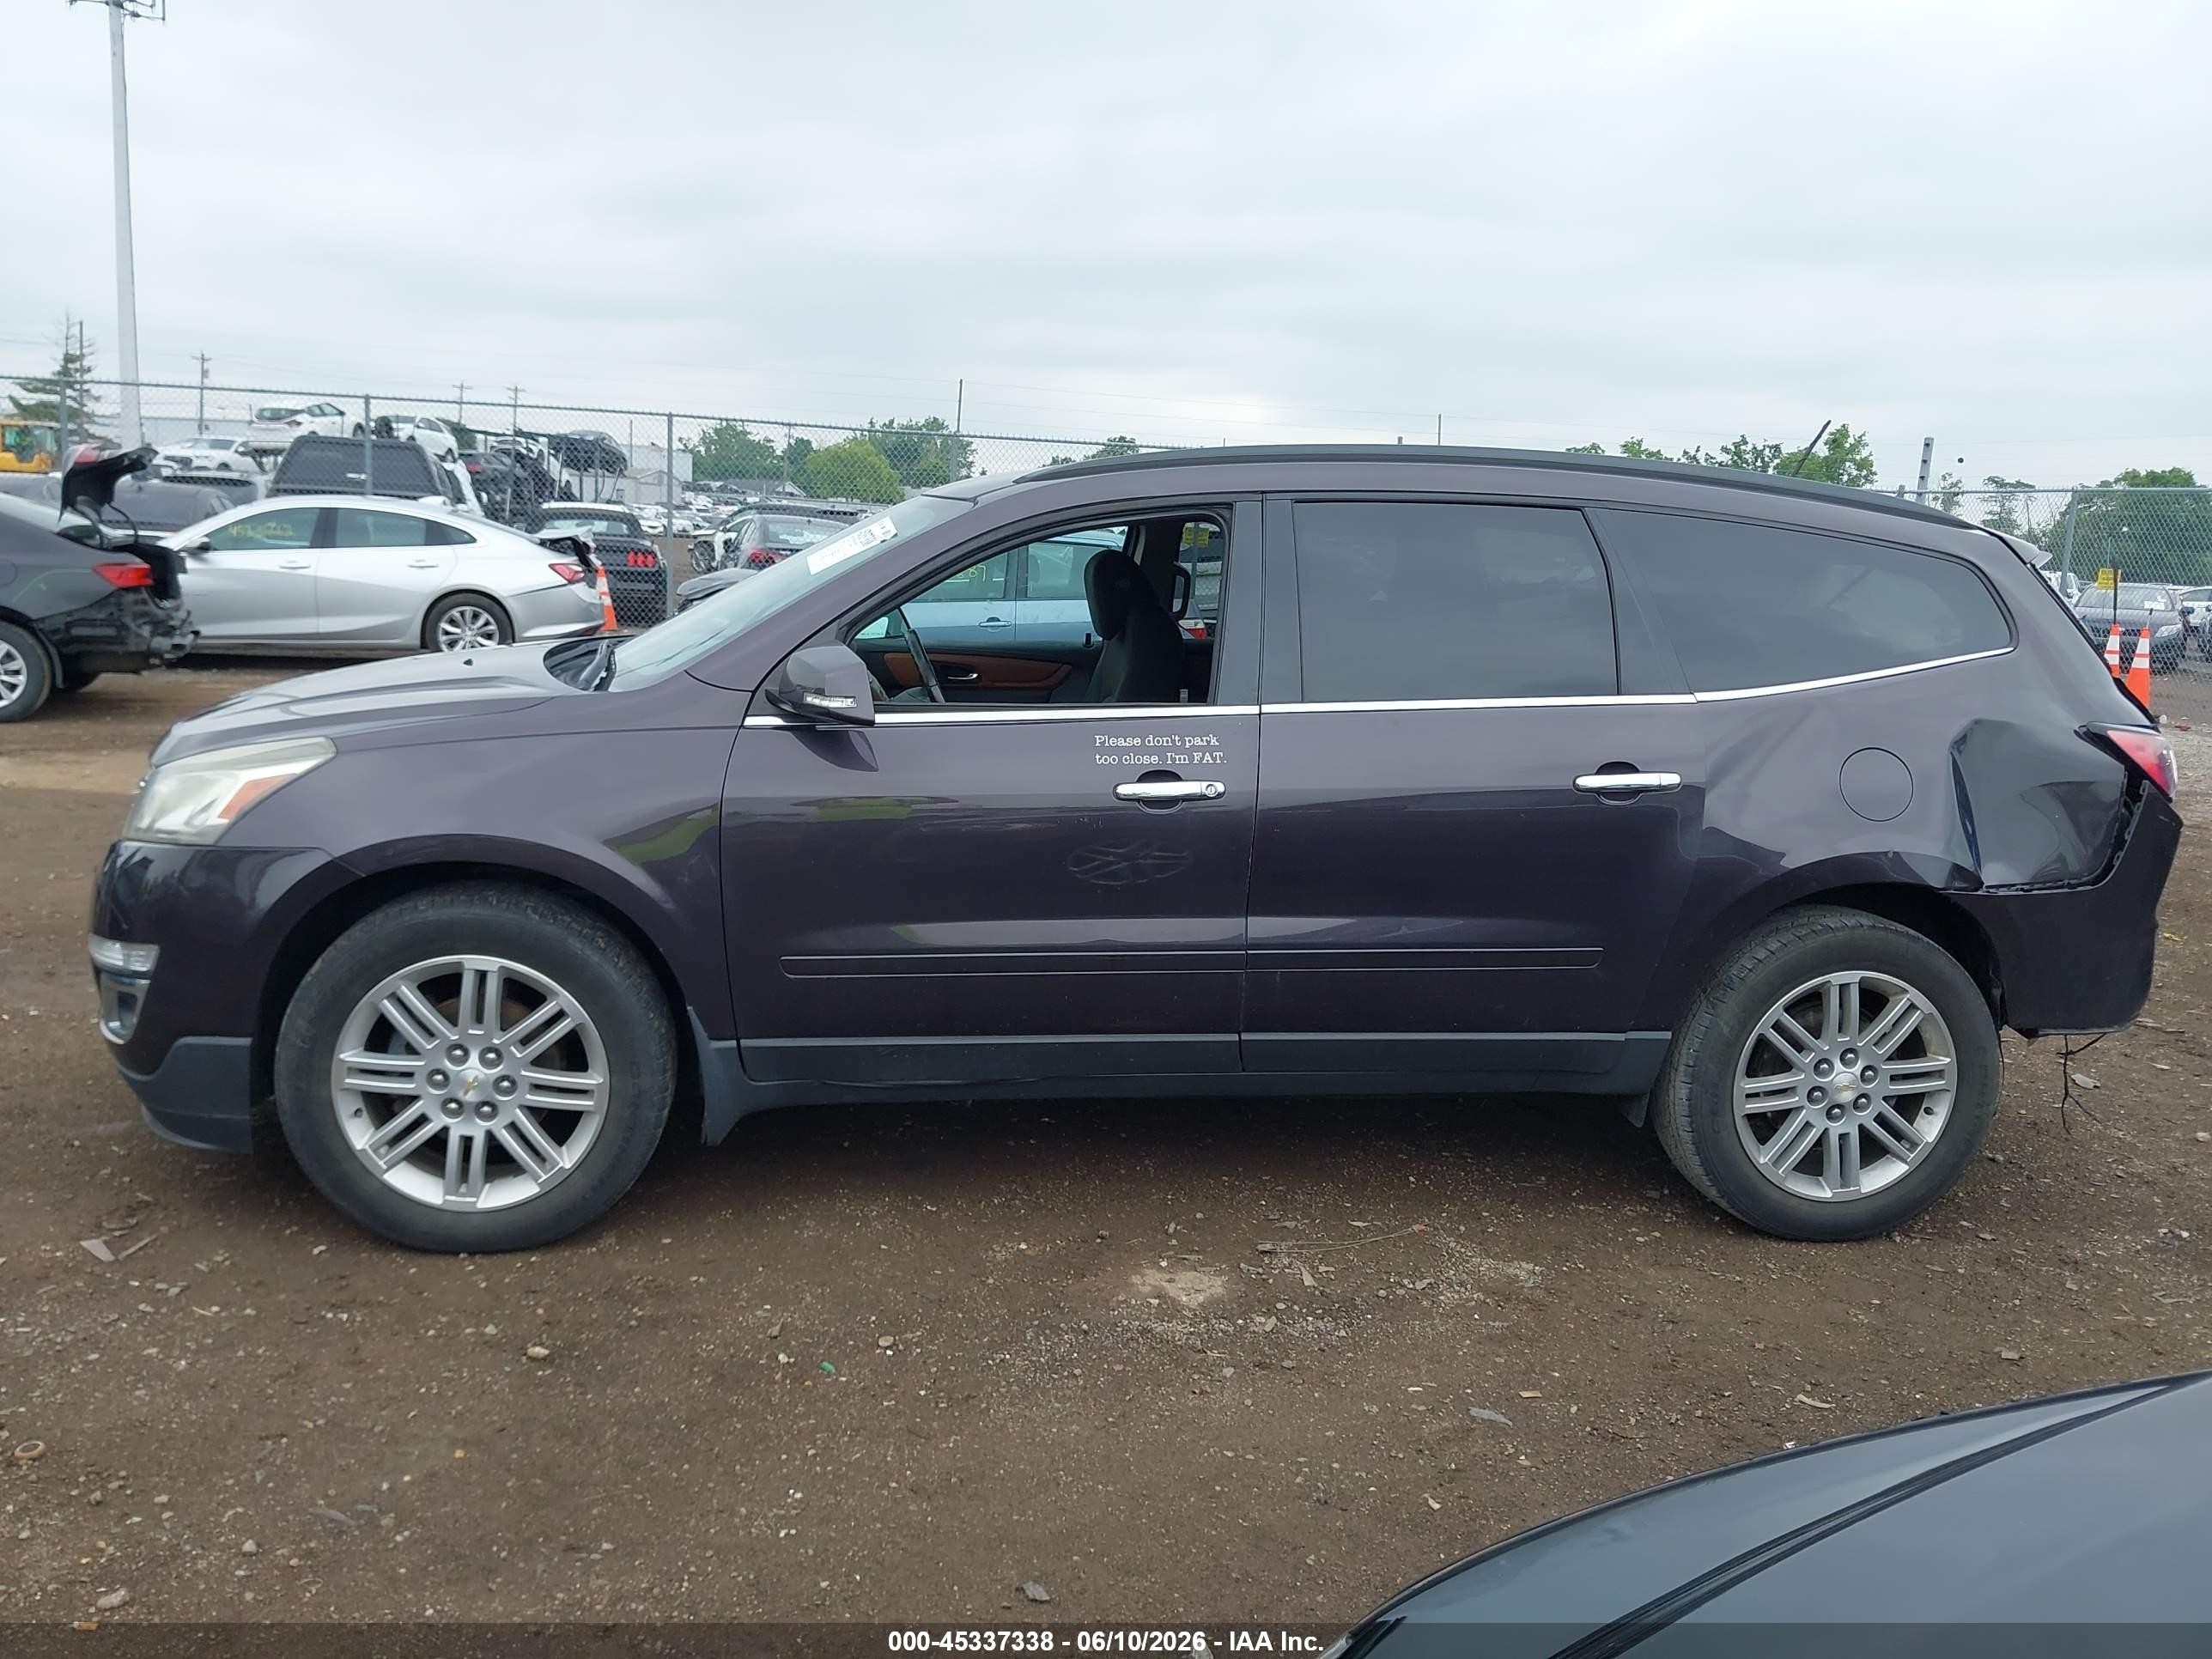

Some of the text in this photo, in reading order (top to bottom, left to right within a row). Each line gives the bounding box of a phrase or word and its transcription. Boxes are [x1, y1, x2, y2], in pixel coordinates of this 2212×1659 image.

[1094, 734, 1220, 749] Please don't park
[1095, 751, 1227, 765] too close. I'm FAT.
